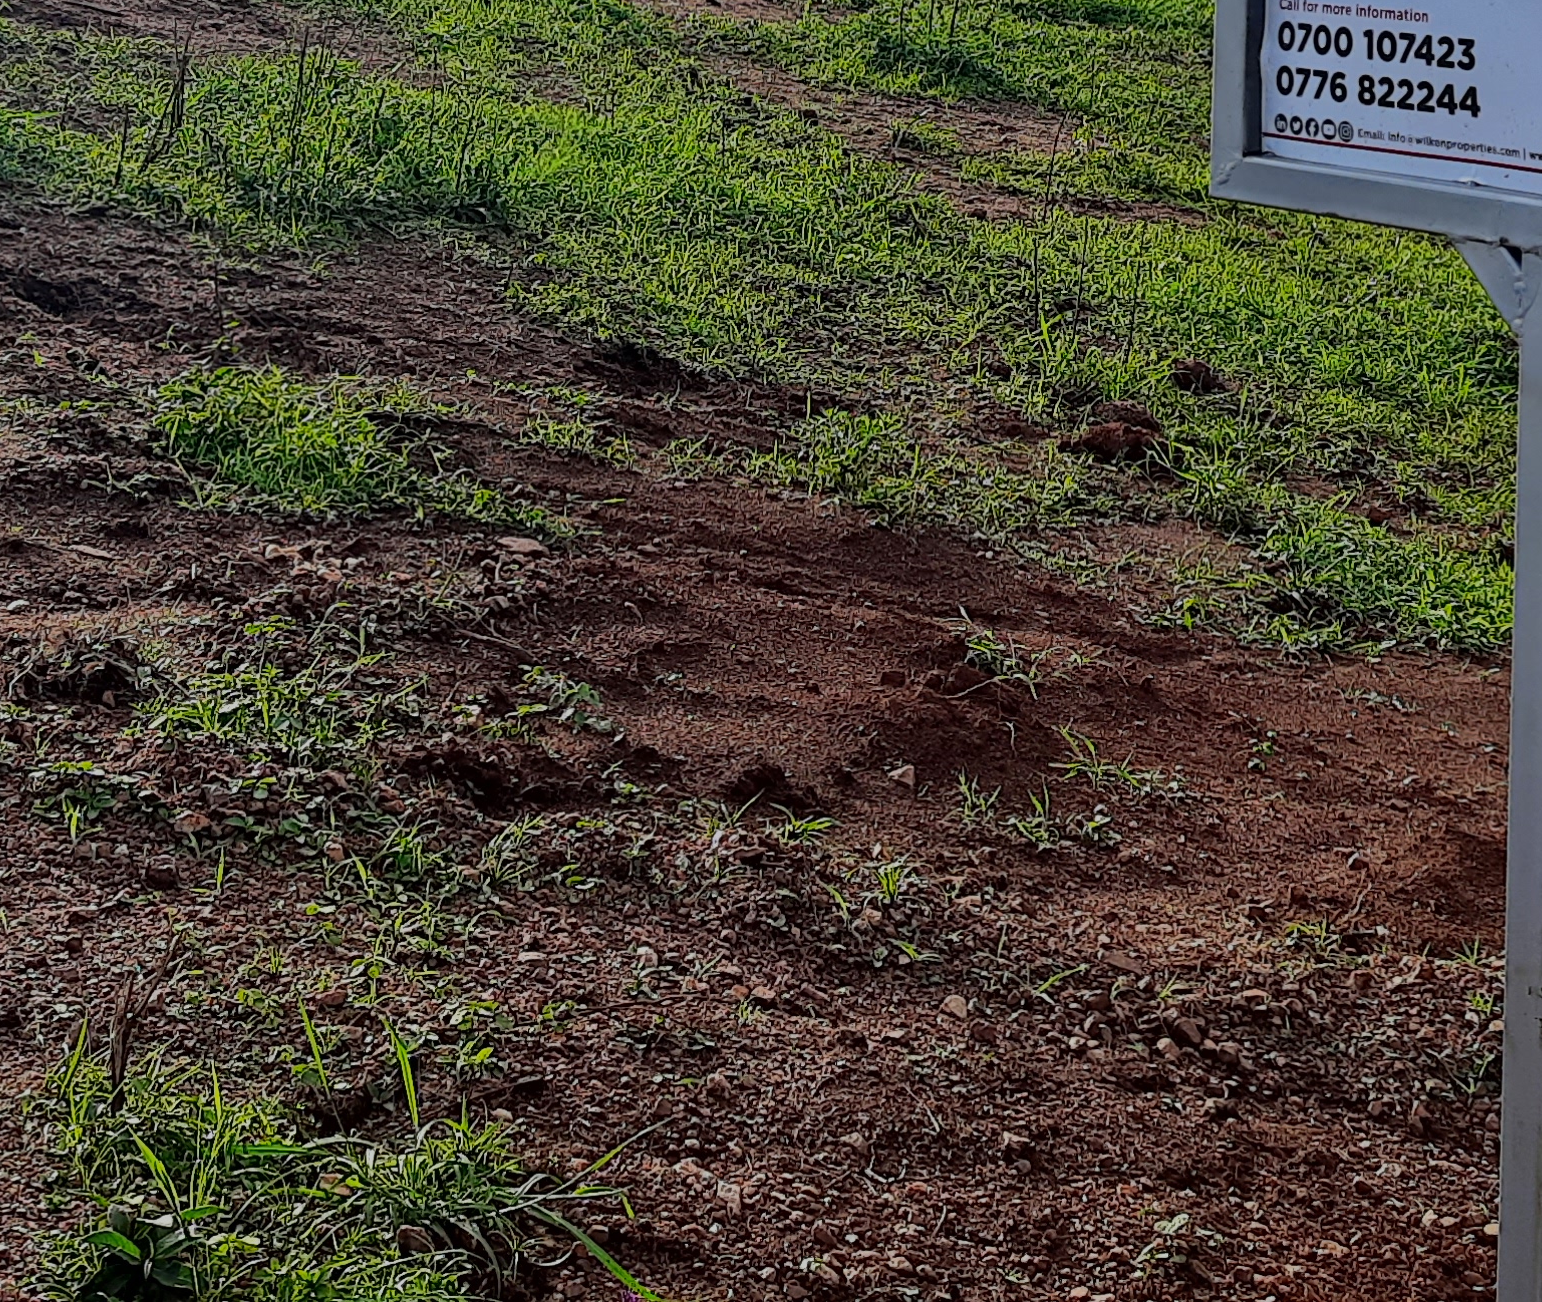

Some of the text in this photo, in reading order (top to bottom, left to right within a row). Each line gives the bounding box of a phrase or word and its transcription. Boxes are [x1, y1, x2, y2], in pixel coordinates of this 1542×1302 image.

[1303, 0, 1319, 14] for
[1322, 4, 1352, 16] more
[1356, 4, 1429, 23] information
[1278, 21, 1476, 71] 0700 107423
[1276, 65, 1481, 118] 0776 822244
